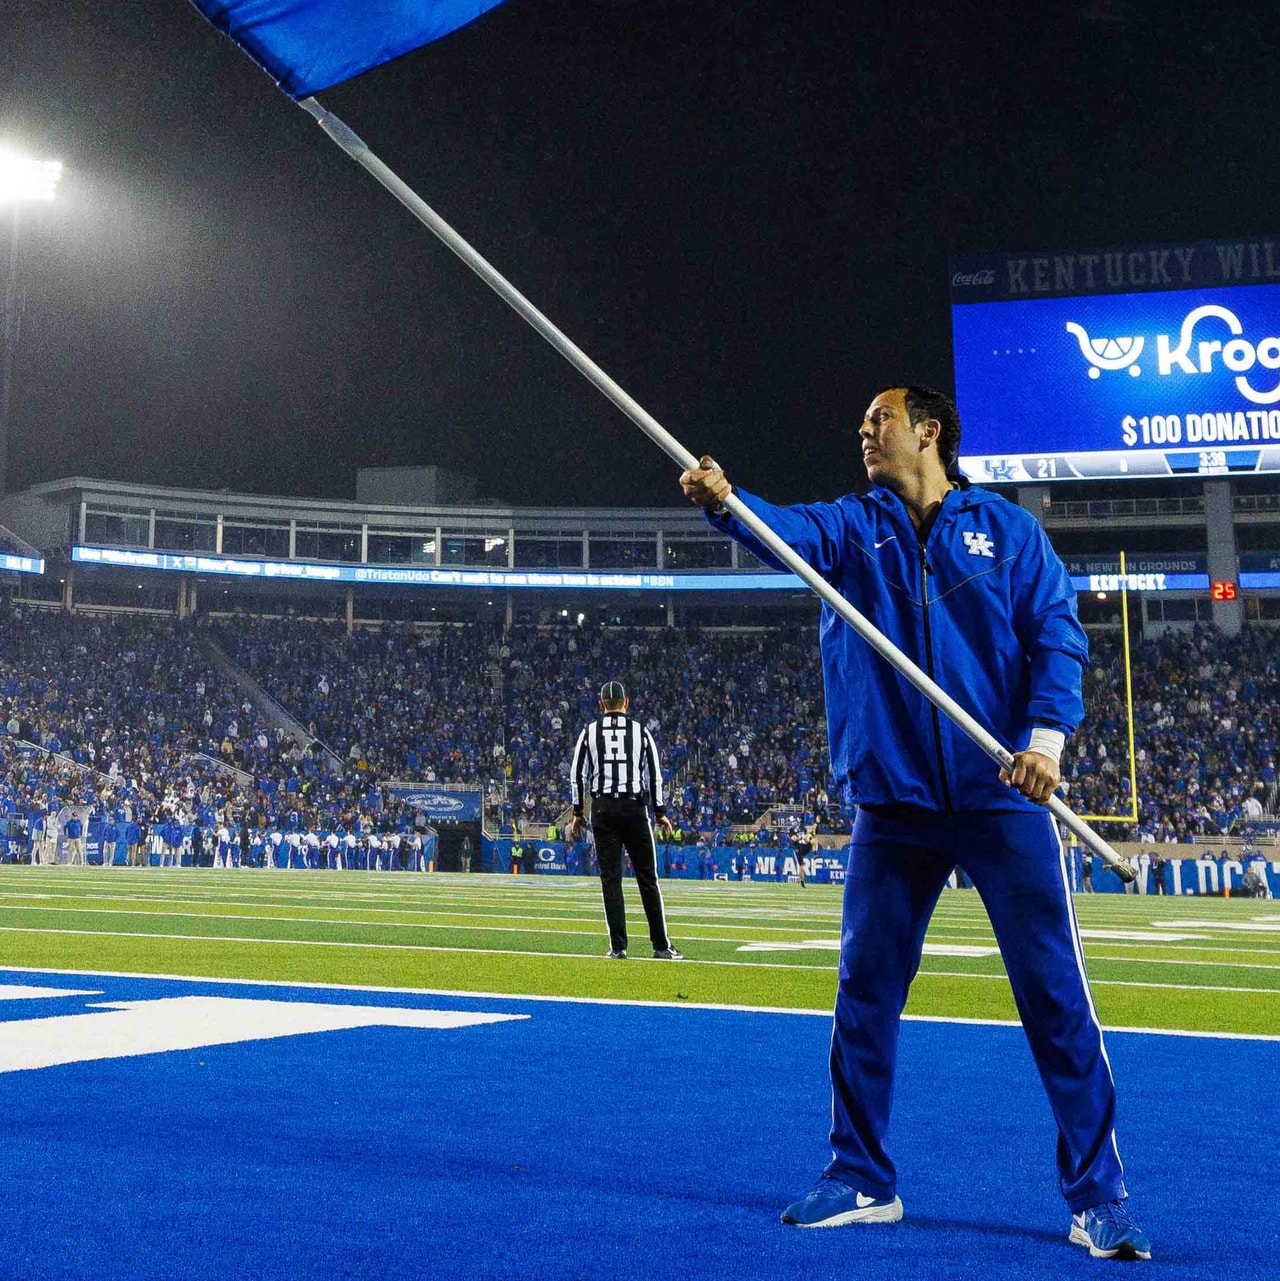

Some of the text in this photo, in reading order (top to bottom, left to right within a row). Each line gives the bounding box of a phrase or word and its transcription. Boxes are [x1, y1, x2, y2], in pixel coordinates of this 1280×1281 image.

[1006, 248, 1196, 293] KENTUCKY
[1122, 415, 1182, 447] $100
[1037, 459, 1057, 478] 21
[962, 531, 995, 558] UK
[1139, 561, 1196, 571] GROUNDS
[1214, 584, 1235, 599] 25
[602, 729, 627, 760] H
